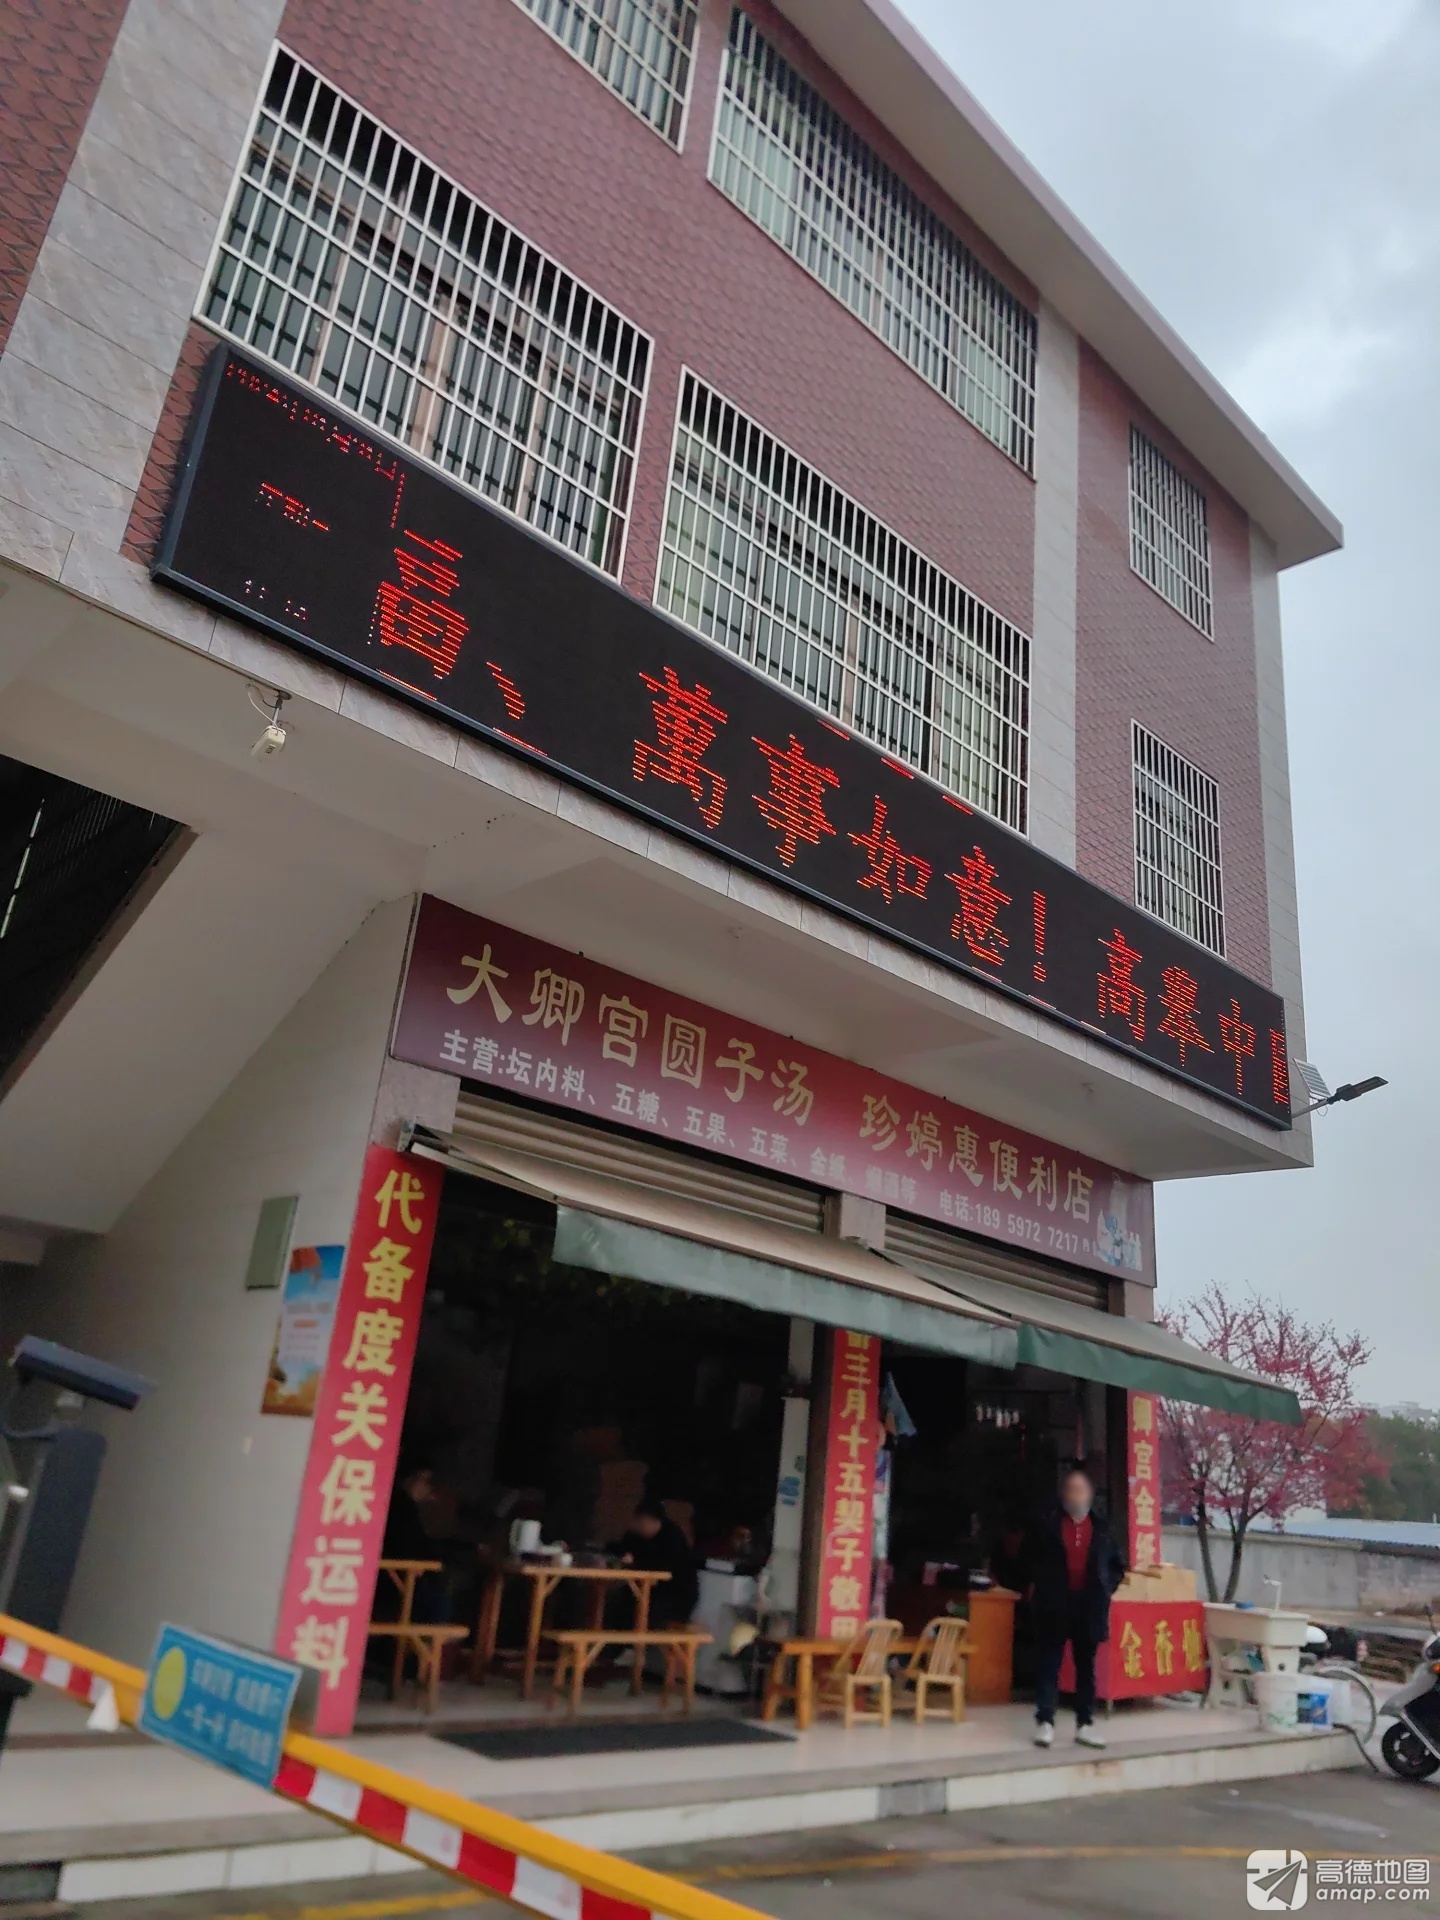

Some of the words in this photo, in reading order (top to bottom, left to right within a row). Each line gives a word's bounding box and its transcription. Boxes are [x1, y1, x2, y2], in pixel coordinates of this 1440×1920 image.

[446, 944, 815, 1127] 大卿宫圆子汤
[858, 1095, 1094, 1224] 珍婷惠便利店
[1008, 1214, 1041, 1242] 5972
[1049, 1225, 1078, 1254] 7217
[290, 1168, 426, 1689] 代备度关保运料
